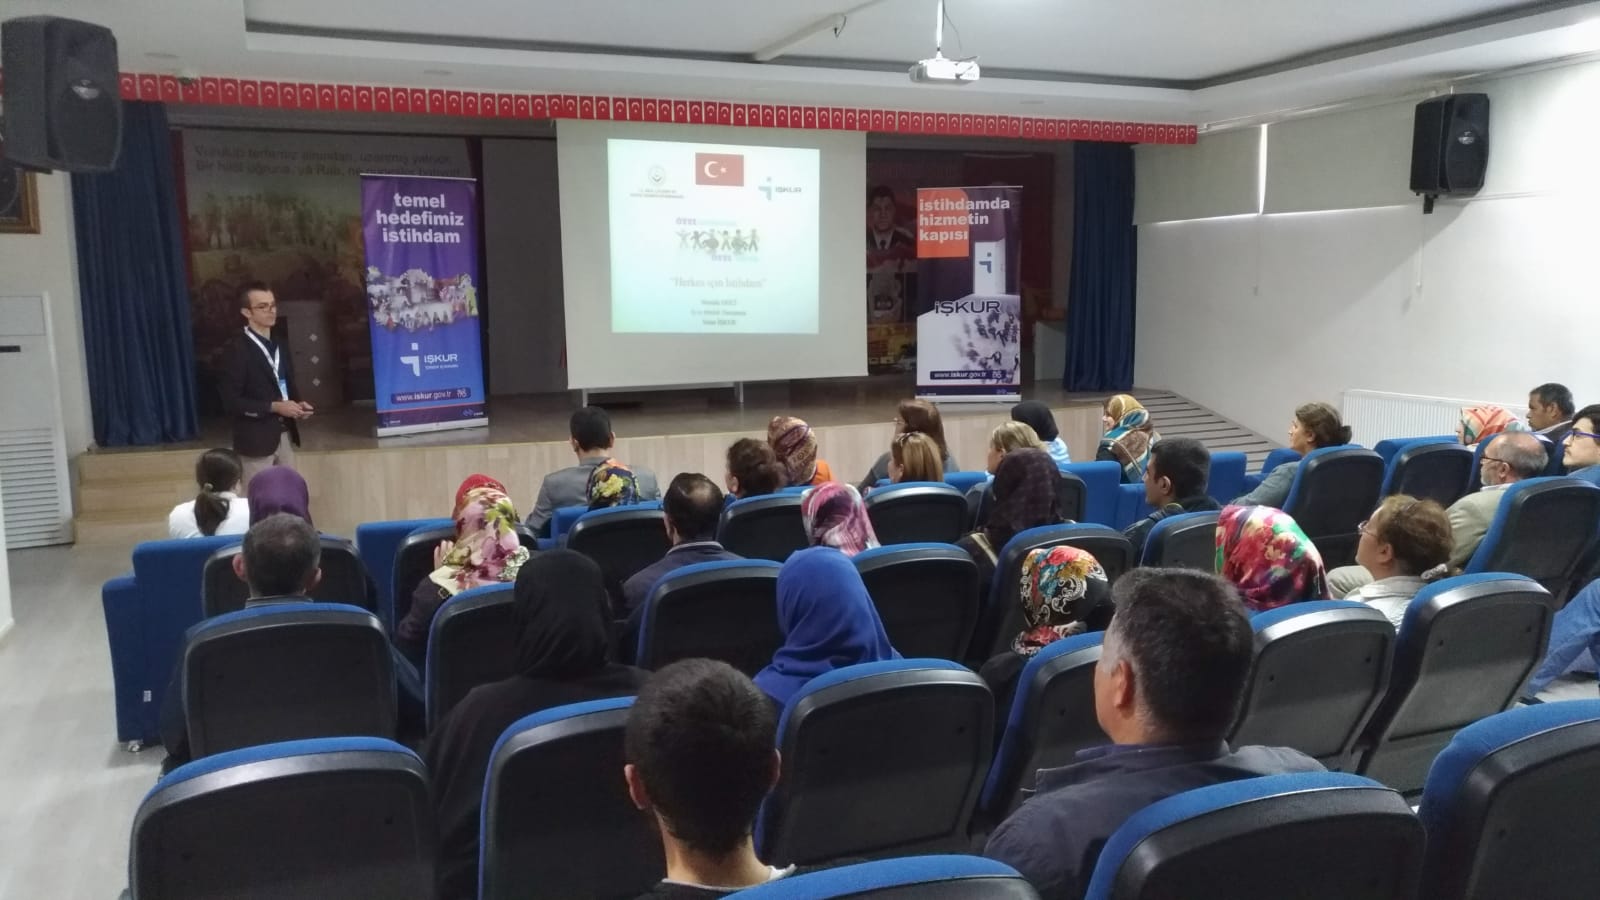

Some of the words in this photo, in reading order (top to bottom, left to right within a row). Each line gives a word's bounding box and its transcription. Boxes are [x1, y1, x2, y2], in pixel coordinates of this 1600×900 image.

[394, 193, 445, 209] temel
[919, 197, 1010, 211] istihdamda
[376, 210, 465, 226] hedefimiz
[919, 213, 989, 226] hizmetin
[382, 227, 460, 243] istihdam
[919, 229, 968, 244] kapısı
